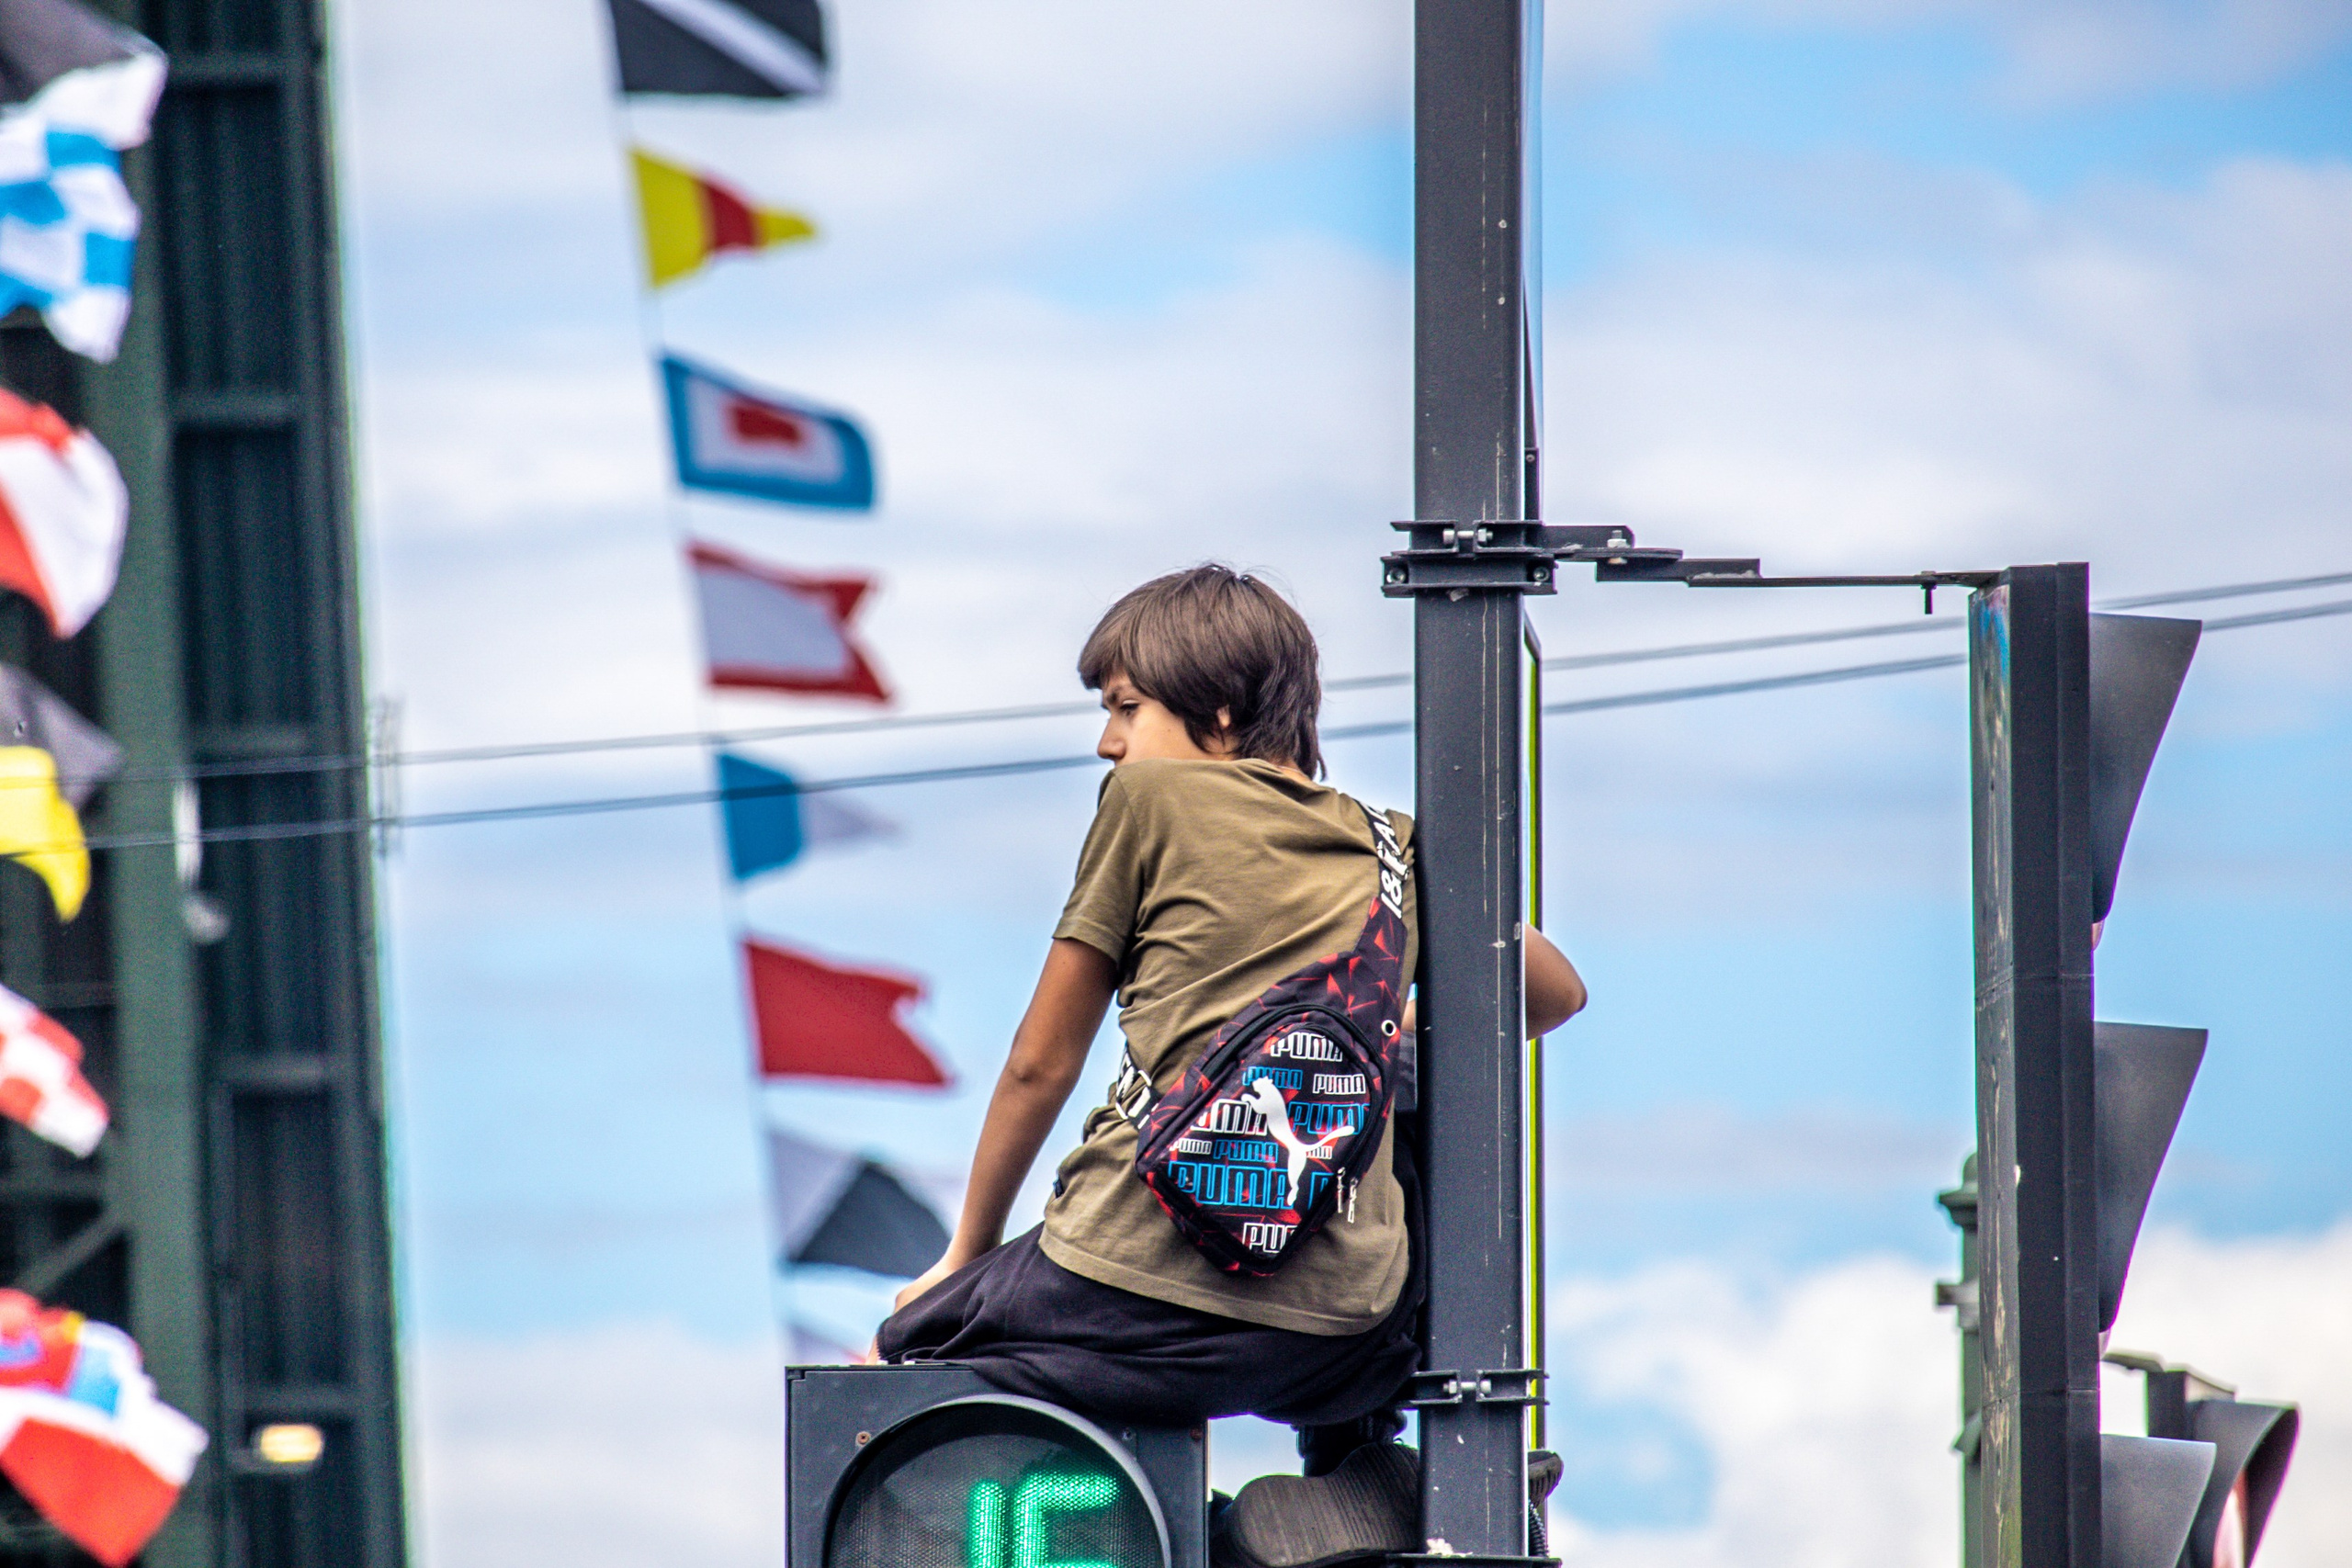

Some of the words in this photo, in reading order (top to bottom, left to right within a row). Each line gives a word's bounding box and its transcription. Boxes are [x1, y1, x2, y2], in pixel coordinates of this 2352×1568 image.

[1312, 1074, 1366, 1095] PUMA
[1288, 1101, 1370, 1135] PUM
[1213, 1139, 1278, 1164] PUMA
